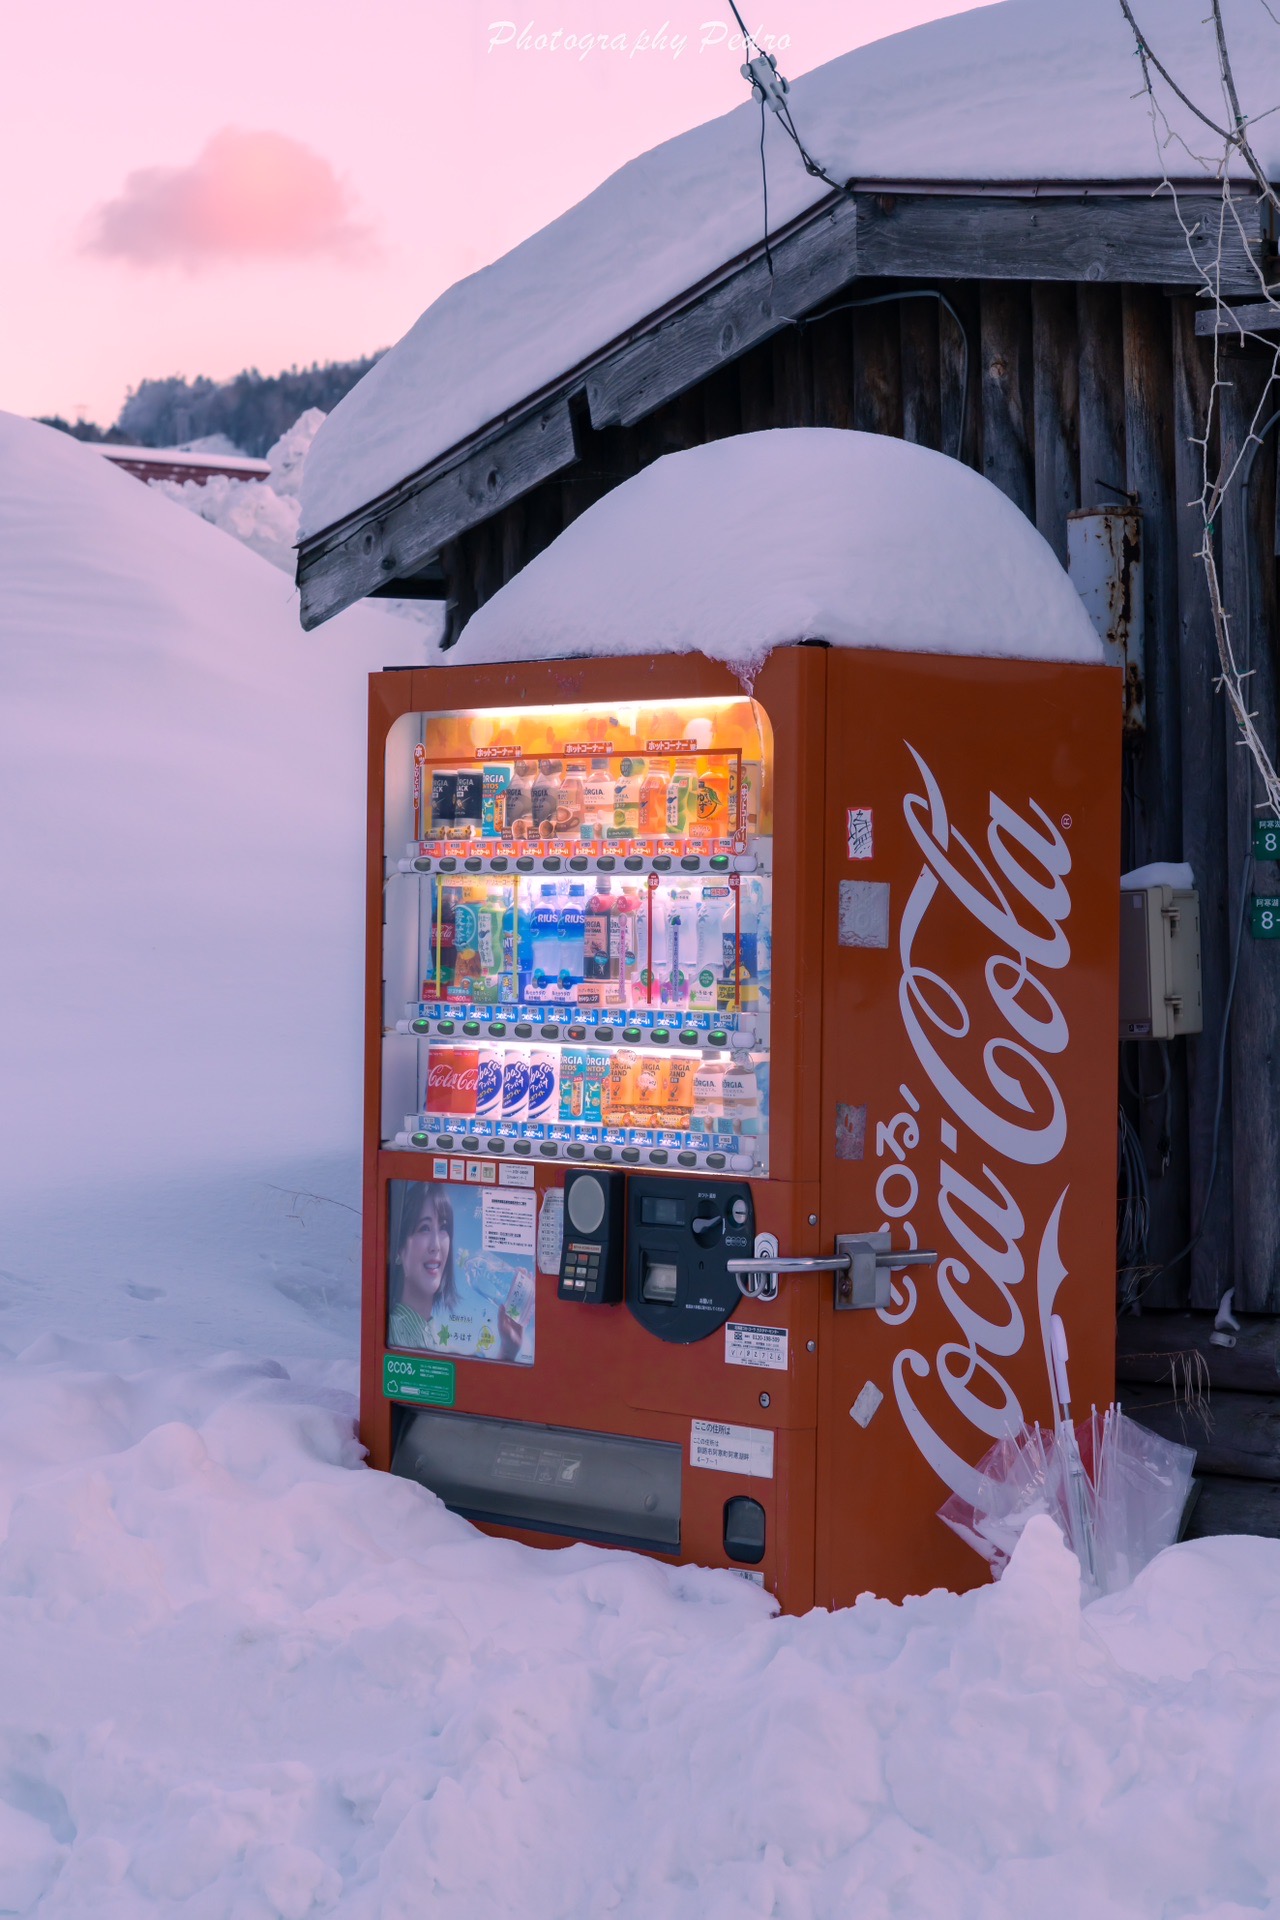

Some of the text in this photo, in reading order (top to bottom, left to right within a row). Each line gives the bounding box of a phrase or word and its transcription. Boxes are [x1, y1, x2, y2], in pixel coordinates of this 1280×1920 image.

[1265, 833, 1277, 851] 8
[892, 738, 1073, 1520] Coca-Cola
[695, 1422, 731, 1436] ここの住所は
